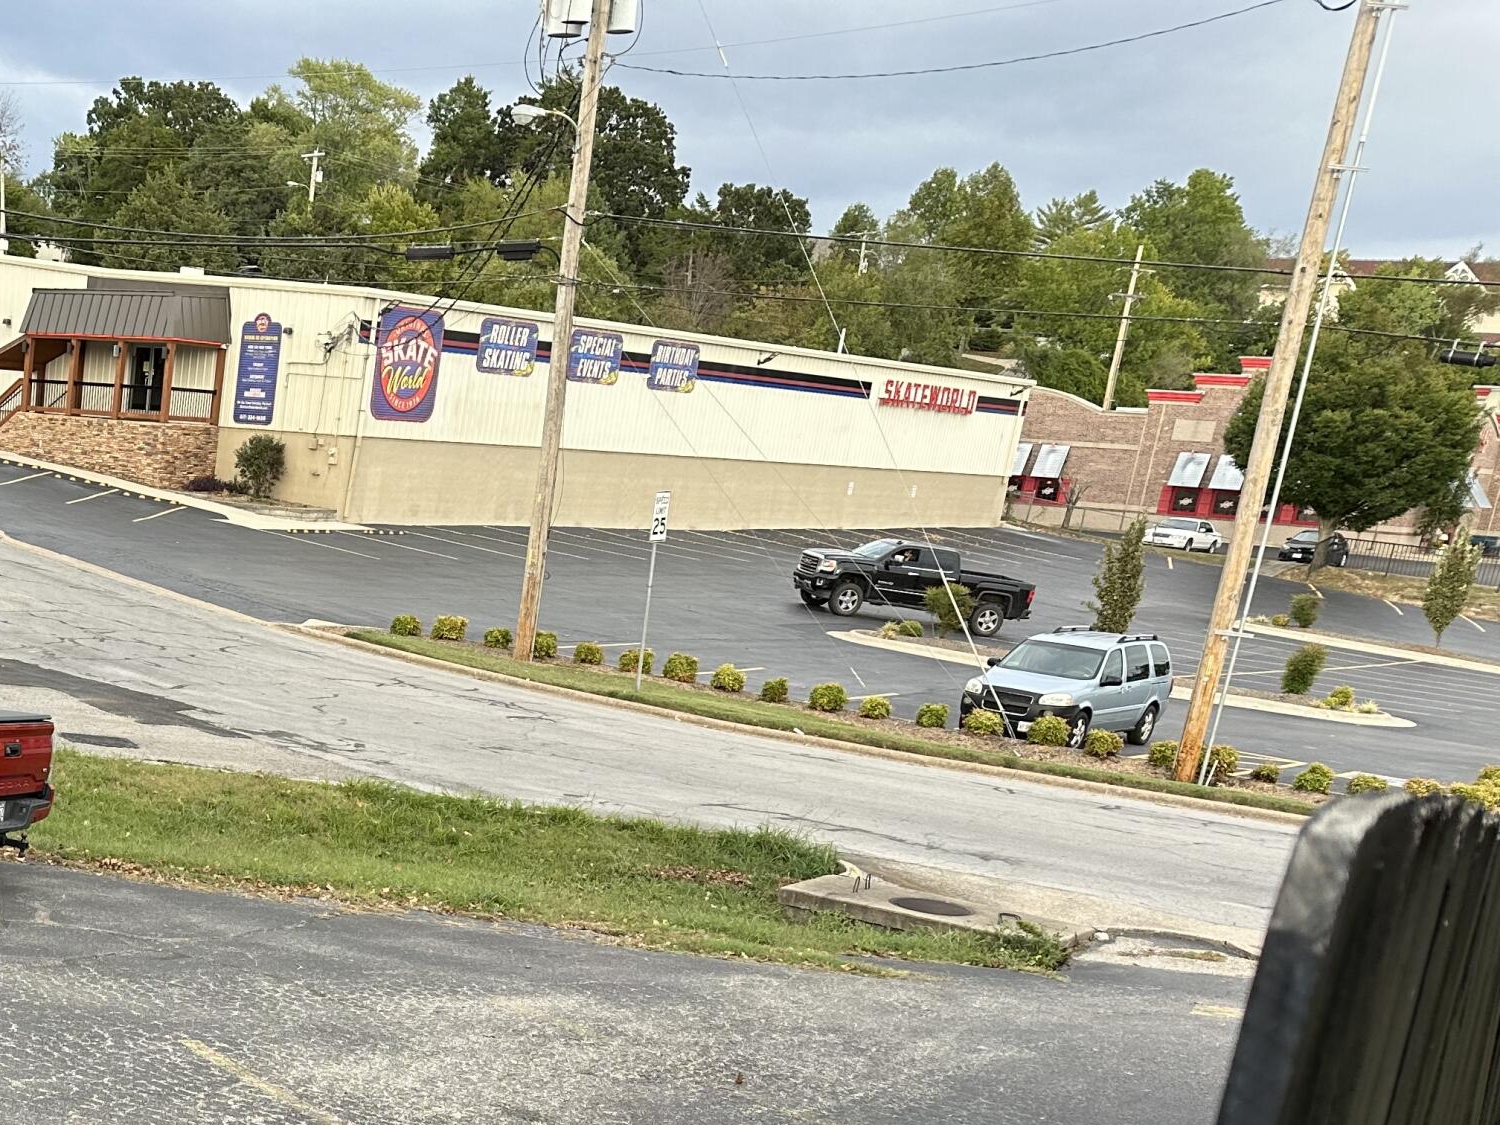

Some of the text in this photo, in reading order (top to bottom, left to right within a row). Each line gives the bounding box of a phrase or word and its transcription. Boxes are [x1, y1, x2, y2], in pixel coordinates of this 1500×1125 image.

[490, 324, 530, 347] ROLLER
[578, 335, 616, 357] SPECIAL
[380, 337, 438, 368] SKATE
[482, 348, 530, 370] SKATING
[655, 345, 696, 366] BIRTHDAY
[381, 365, 432, 394] World
[577, 358, 612, 379] EVENTS
[654, 367, 689, 387] PARTIES
[884, 379, 977, 412] SKATEWORLD
[652, 517, 666, 535] 25
